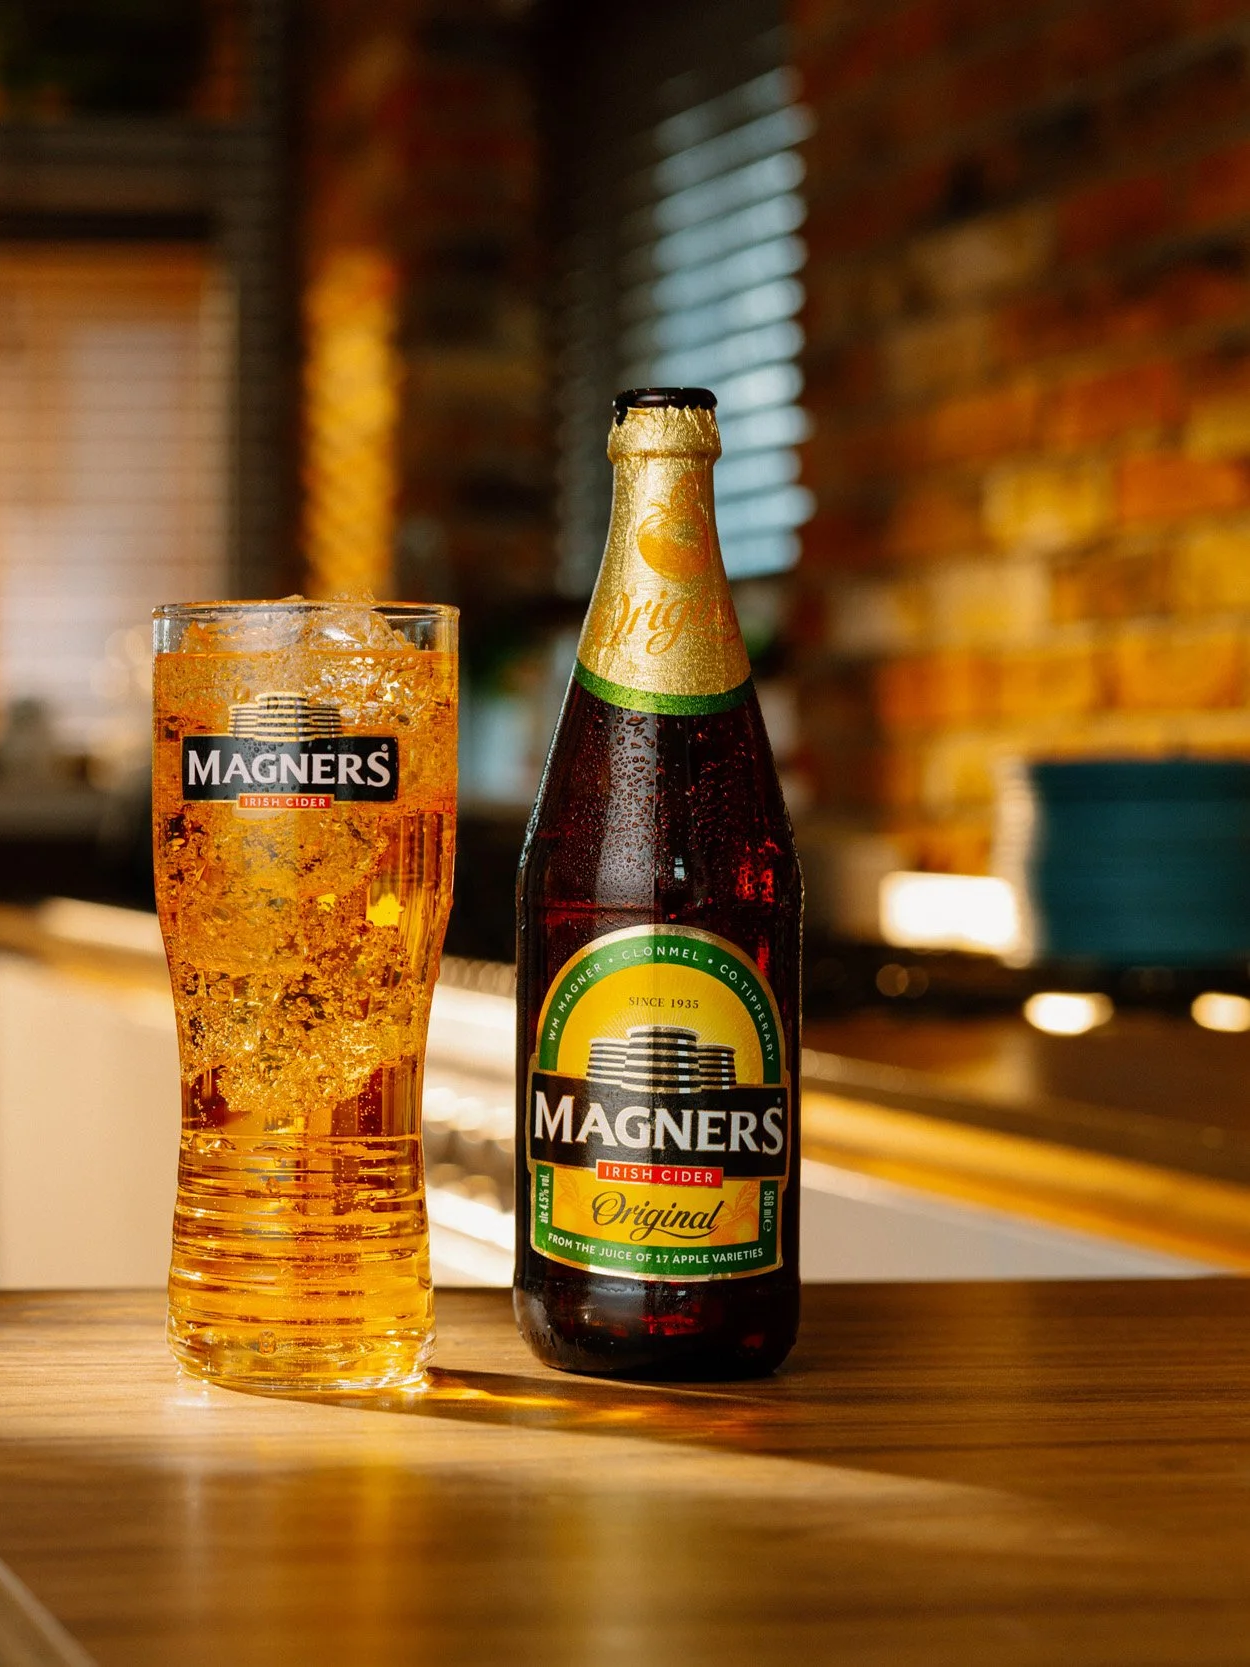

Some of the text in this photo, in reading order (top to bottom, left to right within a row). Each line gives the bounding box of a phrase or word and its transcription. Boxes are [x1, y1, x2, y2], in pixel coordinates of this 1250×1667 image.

[244, 796, 327, 808] IRISH CIDER
[548, 1017, 560, 1041] WM
[557, 963, 603, 1013] MAGNER
[621, 945, 699, 961] CLONMEL
[628, 996, 700, 1009] SINCE 1935
[534, 1089, 784, 1156] MAGNERS
[604, 1165, 713, 1184] IRISH CIDER
[538, 1172, 551, 1225] alc 4.5% vol.
[763, 1189, 775, 1207] 568
[591, 1190, 725, 1242] Original
[547, 1232, 764, 1265] FROM THE JUICE OF 17 APPLE VARIETIES
